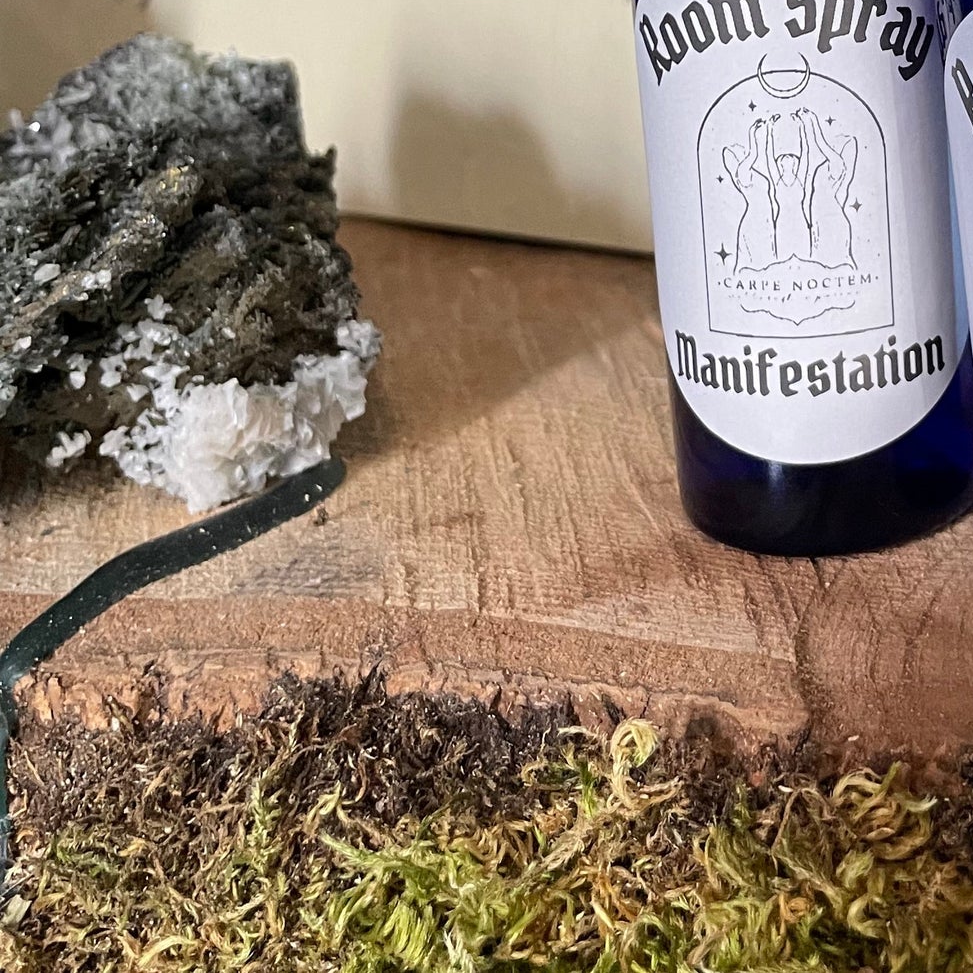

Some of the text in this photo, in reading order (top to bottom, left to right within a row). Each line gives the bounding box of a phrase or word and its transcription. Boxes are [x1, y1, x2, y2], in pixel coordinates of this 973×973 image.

[723, 273, 872, 291] CARPE NOCTEM
[675, 329, 945, 397] Manifestation
